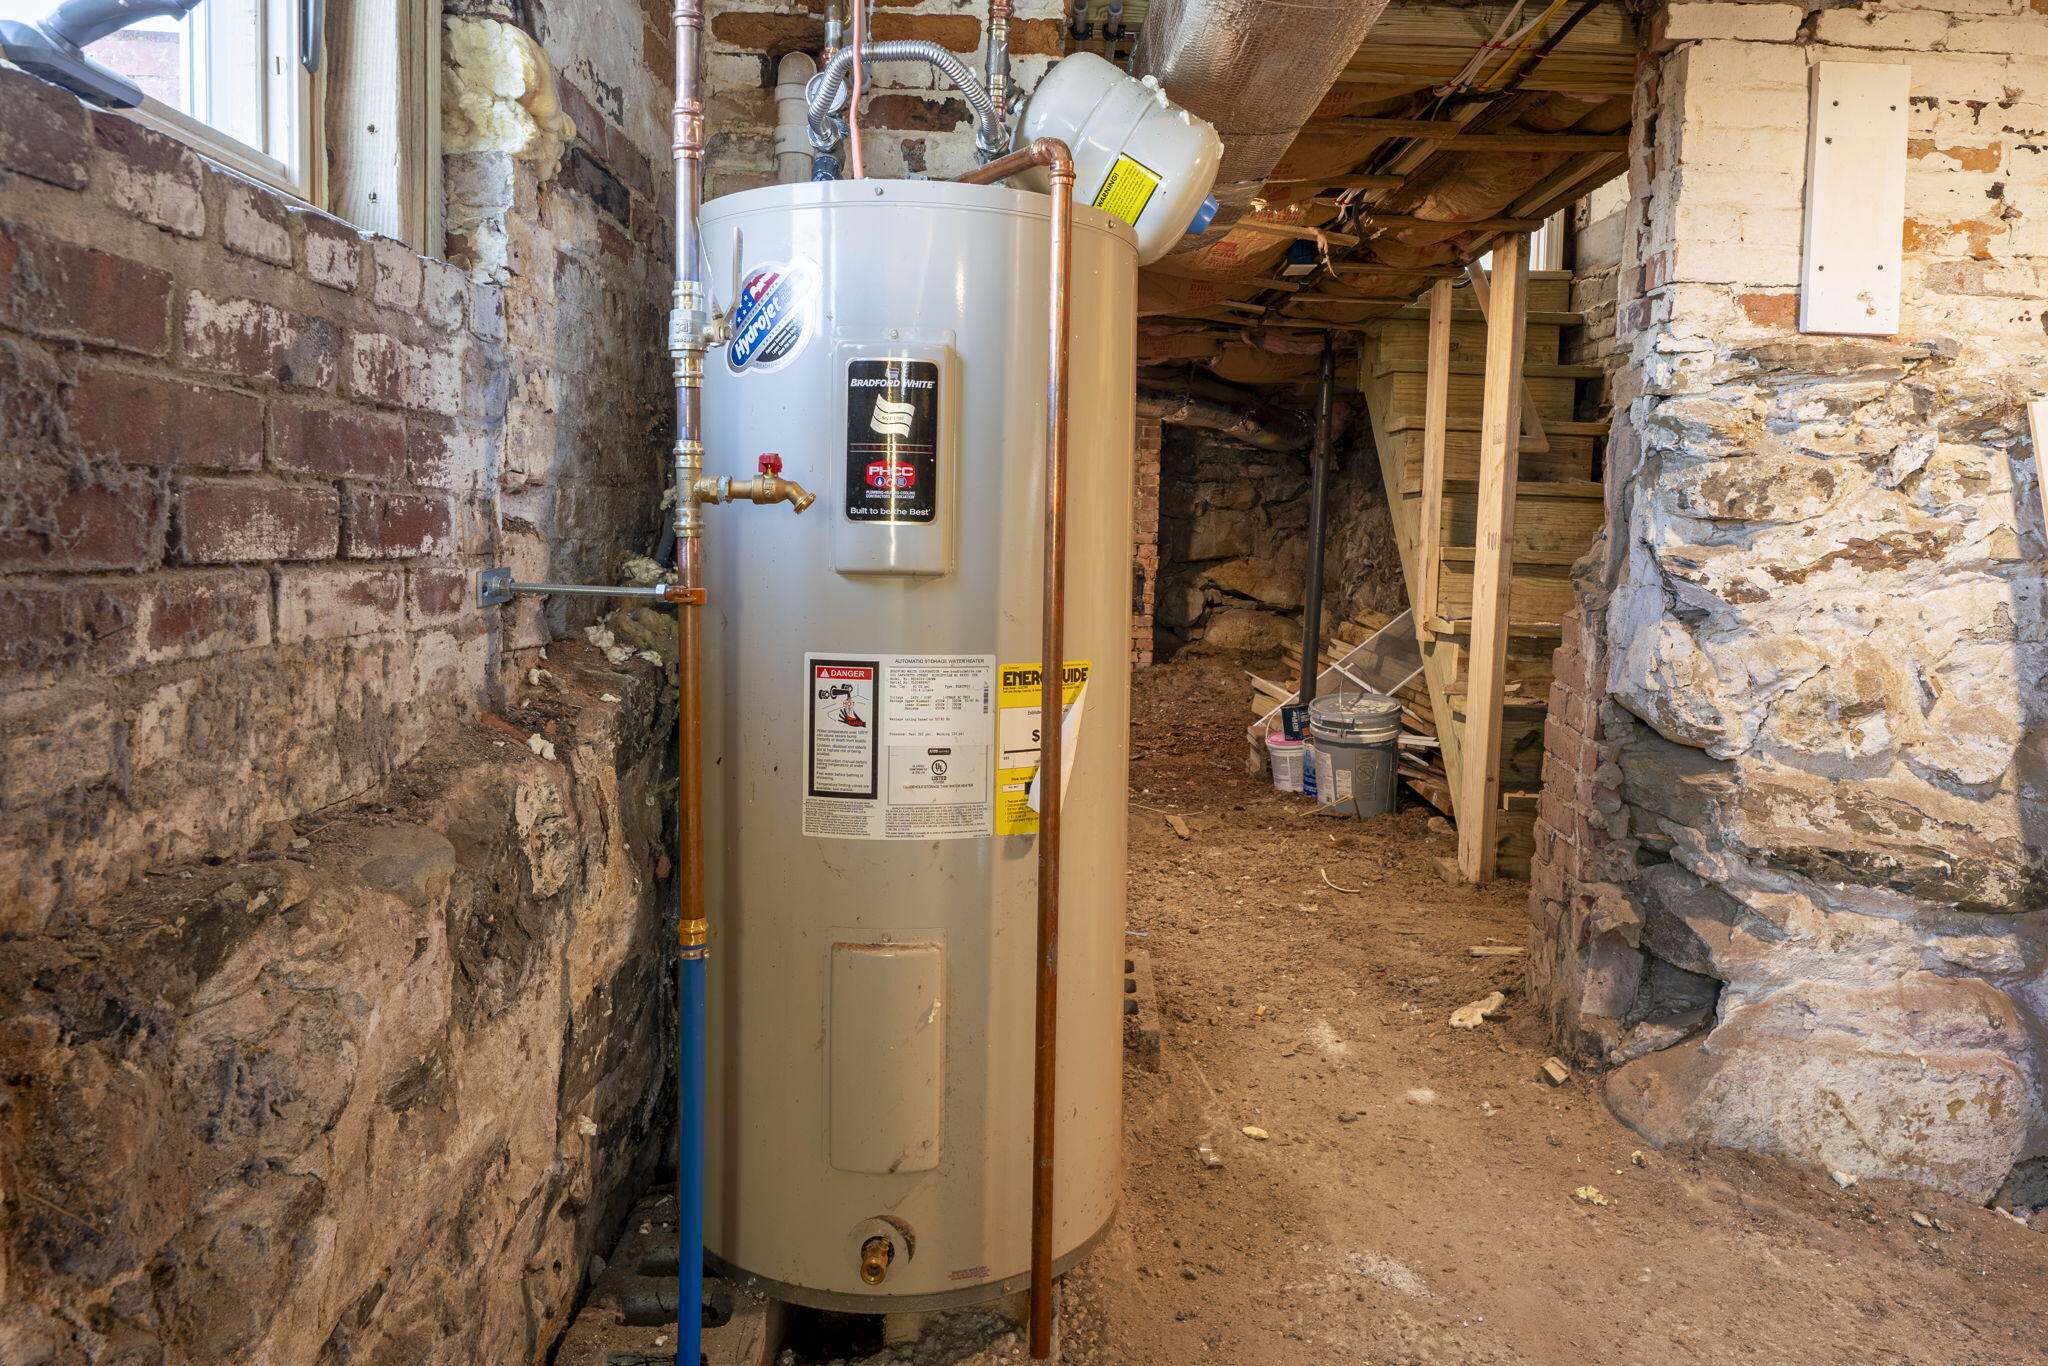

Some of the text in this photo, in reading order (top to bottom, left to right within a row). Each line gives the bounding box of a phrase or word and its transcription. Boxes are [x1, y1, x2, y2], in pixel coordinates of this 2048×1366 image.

[1097, 173, 1119, 207] WARNING!
[735, 296, 782, 360] Hydrojet
[851, 379, 934, 389] BRADFORD WHITE
[869, 466, 914, 477] PHCC
[850, 507, 868, 515] Built
[830, 669, 865, 678] DANGER
[1031, 729, 1041, 743] $
[935, 762, 945, 773] UL
